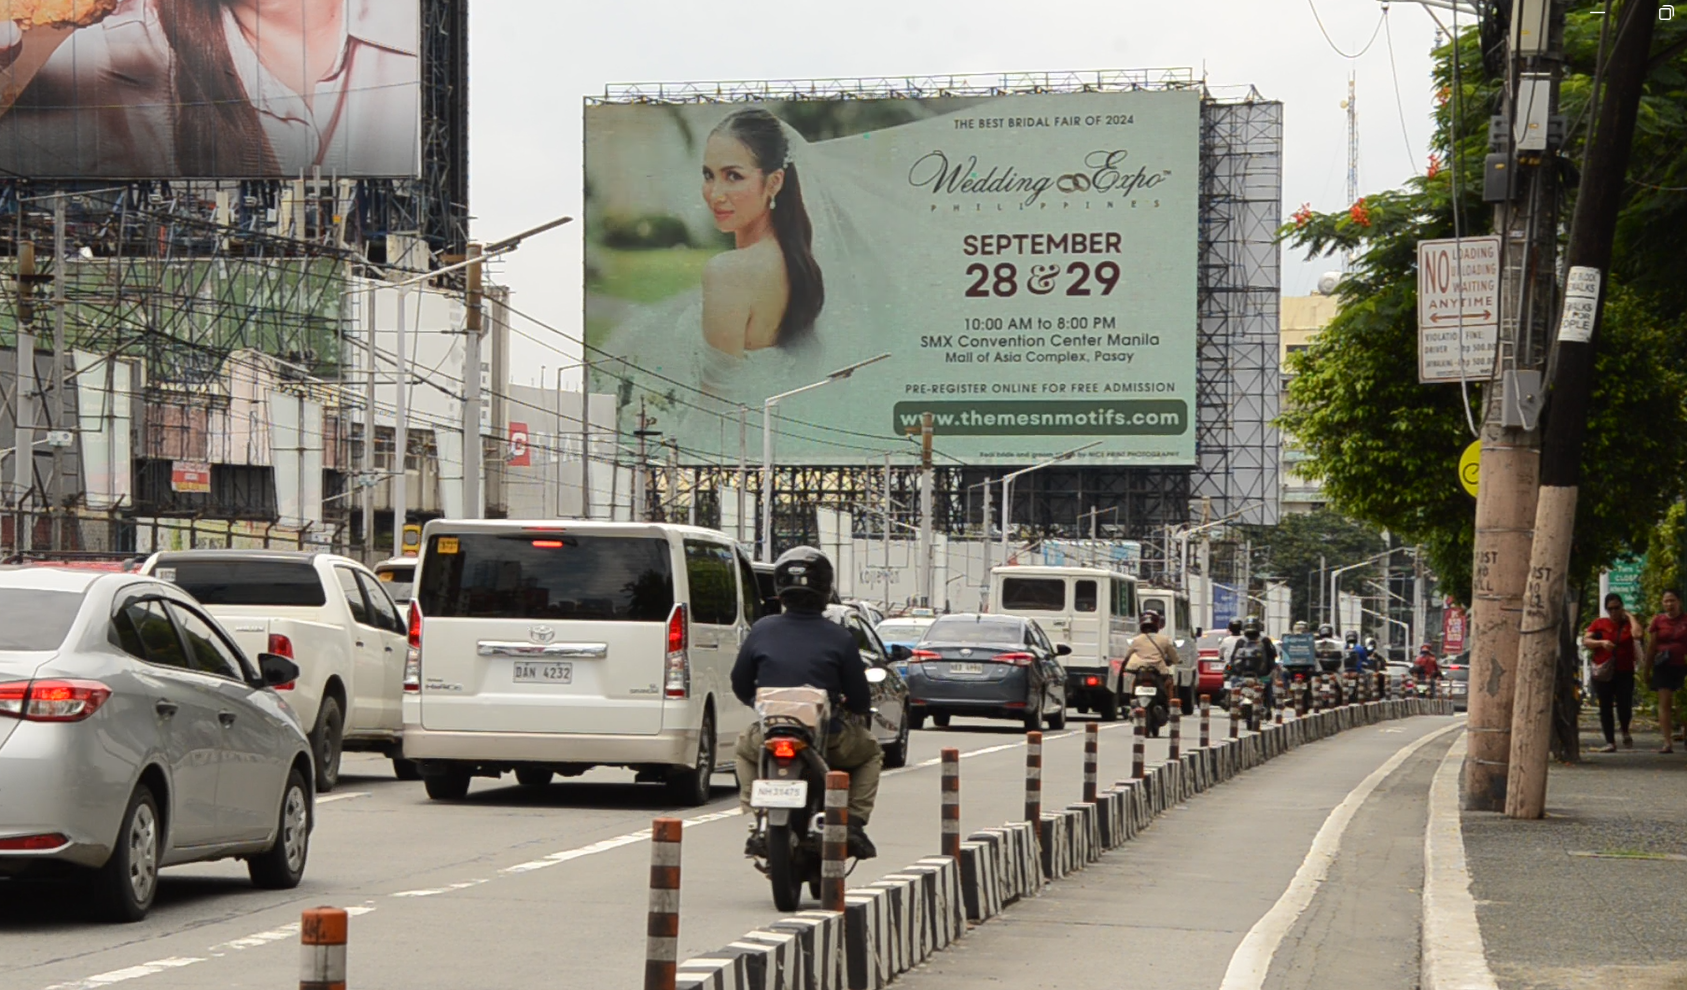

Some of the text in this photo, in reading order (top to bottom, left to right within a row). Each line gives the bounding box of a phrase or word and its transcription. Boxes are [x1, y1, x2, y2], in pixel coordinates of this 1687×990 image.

[954, 114, 1134, 130] THE BEST BRIDAL FAIR OF 2024
[908, 150, 1054, 207] Wedding
[930, 200, 1160, 212] PHILIPPINES
[963, 232, 1122, 256] SEPTEMBER
[1425, 249, 1450, 294] NO
[1451, 263, 1497, 277] ULOADING
[964, 261, 1121, 298] 28 & 29
[1452, 279, 1495, 293] WAITING
[1429, 296, 1493, 309] ANYTIME
[964, 316, 1116, 330] 10:00 AM to 8:00 PM
[920, 333, 1160, 348] SMX Convention Center Manila
[1425, 332, 1461, 342] VIOLATIO
[945, 350, 1135, 364] Mall of Asia Complex, Pasay
[905, 382, 1175, 394] PRE-REGISTER ONLINE FOR FREE ADMISSION
[514, 664, 571, 680] DAN 4232
